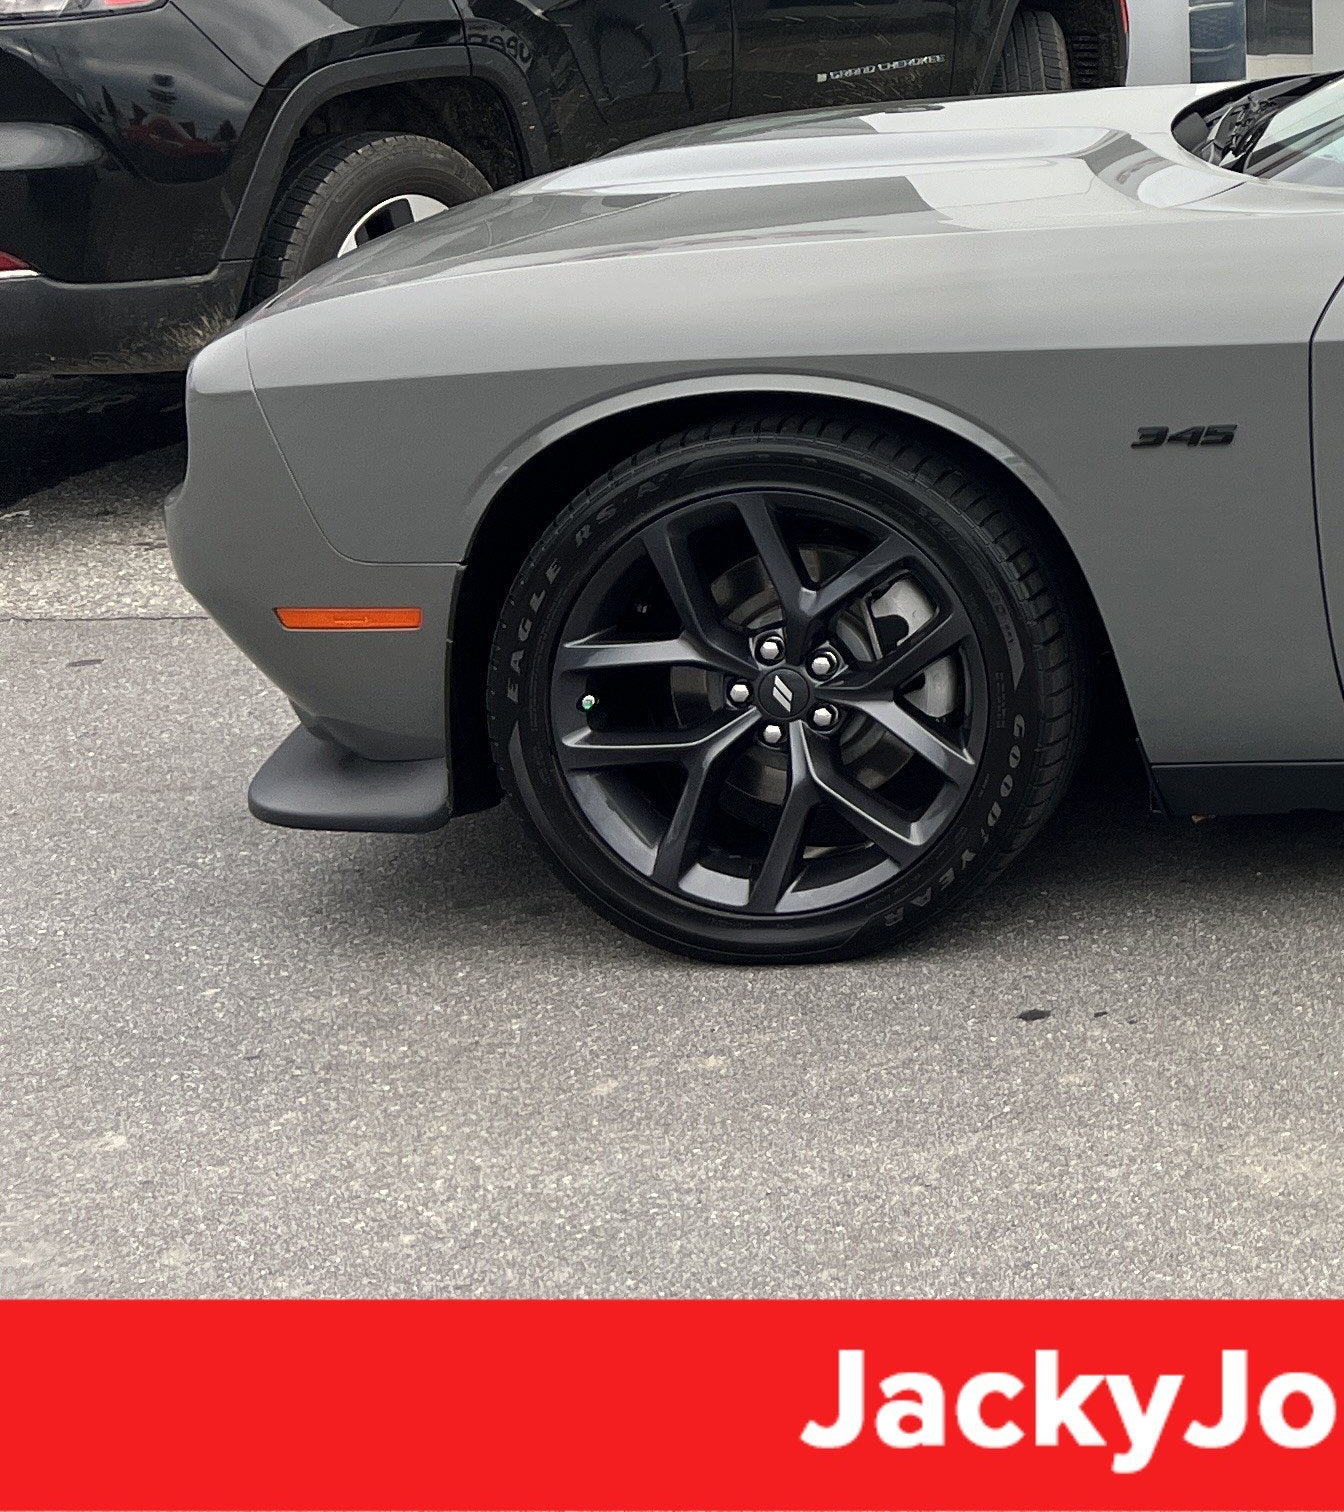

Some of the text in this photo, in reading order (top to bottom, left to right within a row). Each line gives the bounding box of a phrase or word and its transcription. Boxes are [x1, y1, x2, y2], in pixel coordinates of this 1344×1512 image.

[829, 64, 876, 80] GRAND
[1130, 423, 1239, 449] 345
[506, 560, 562, 704] EAGLE
